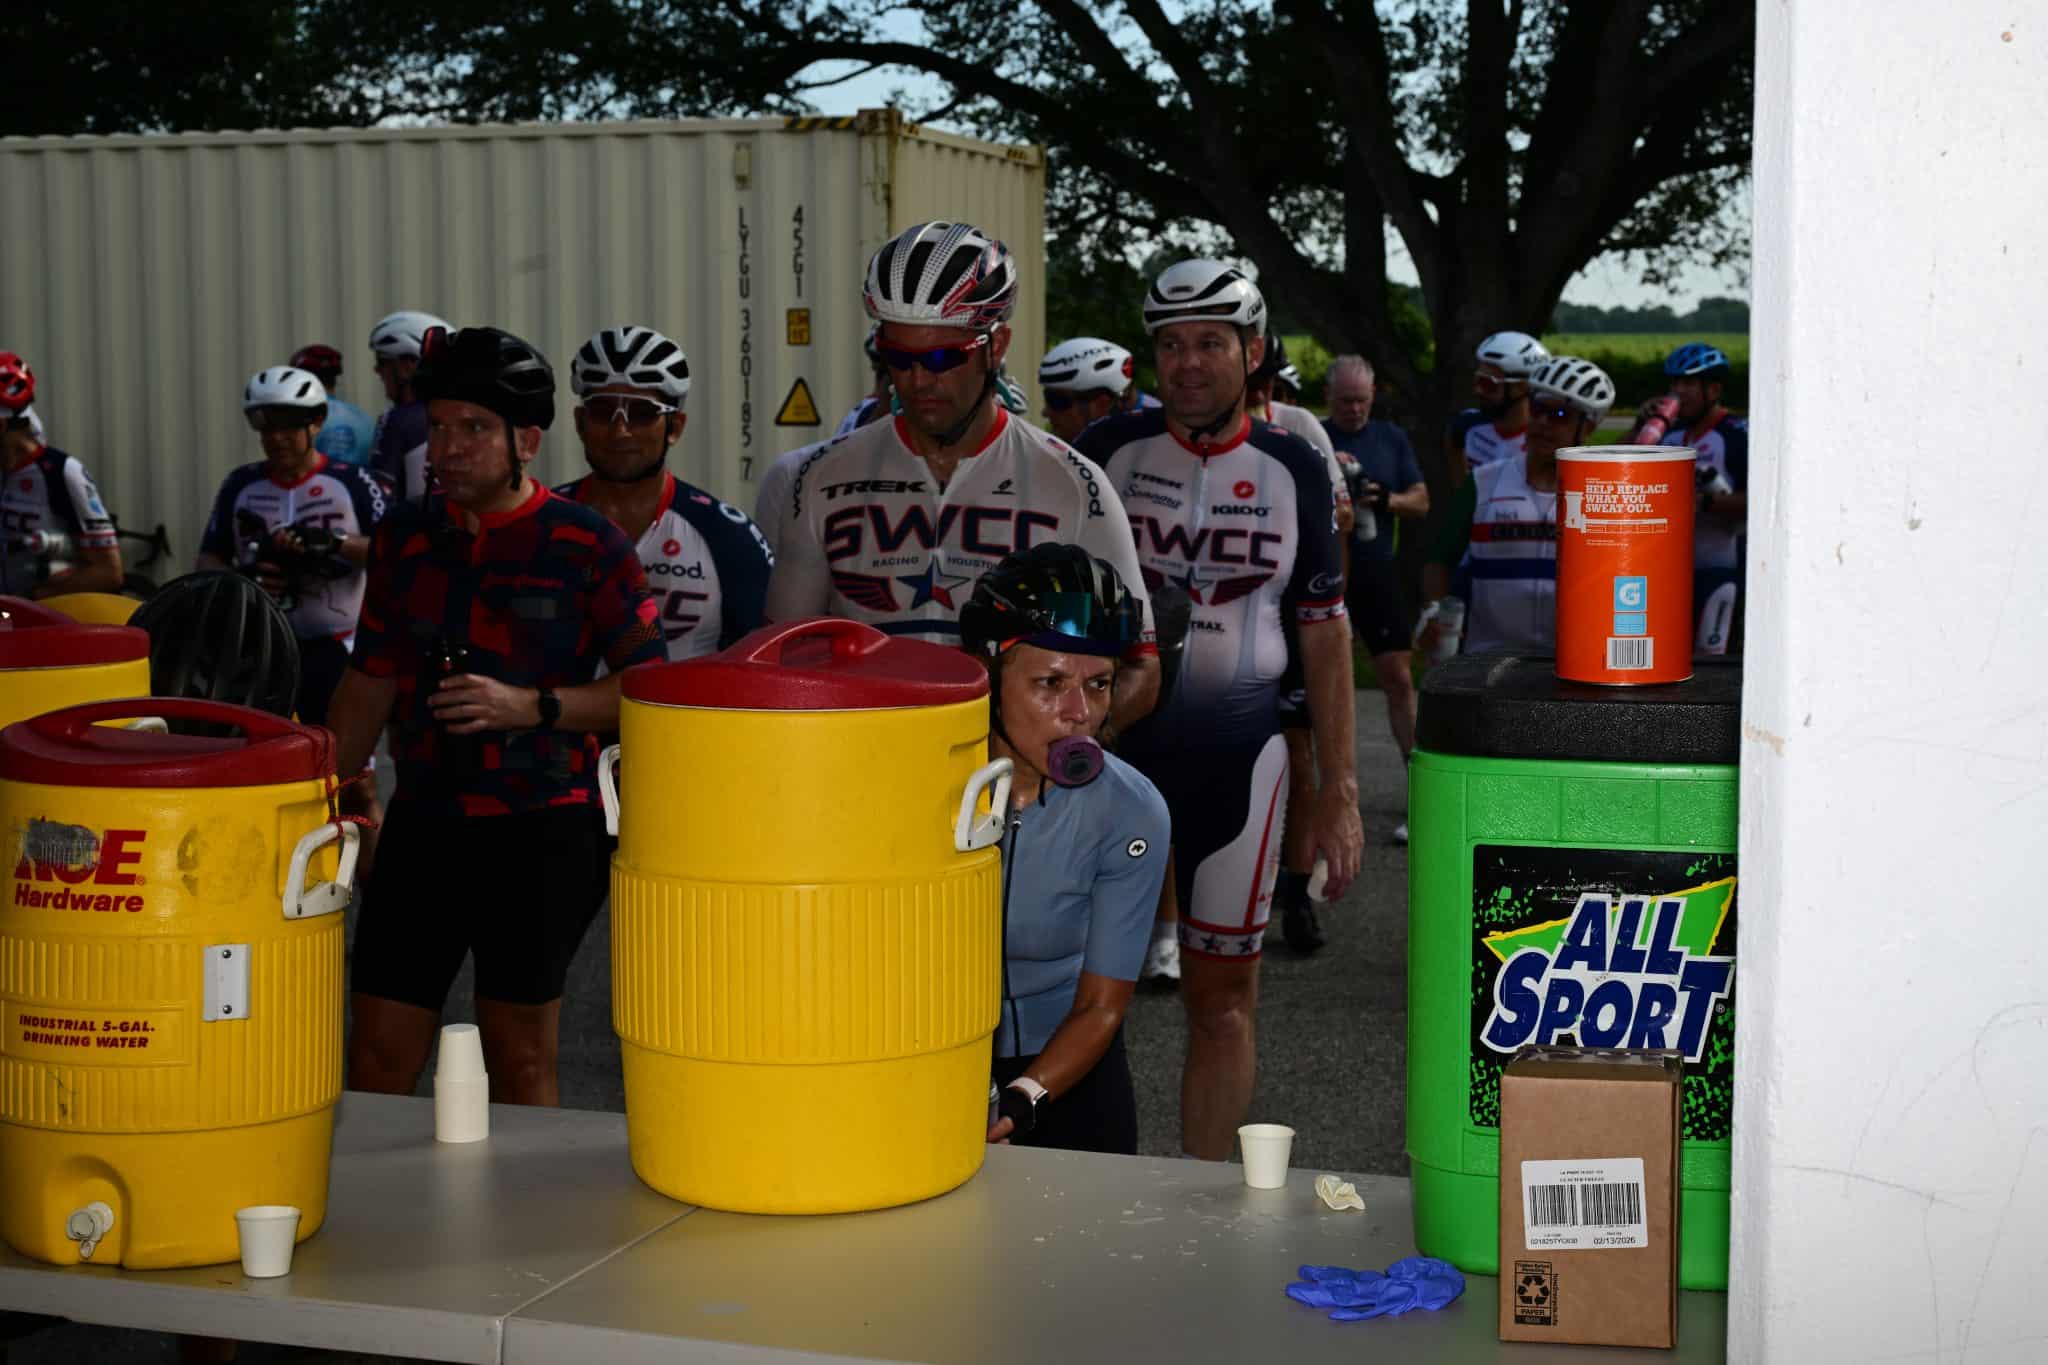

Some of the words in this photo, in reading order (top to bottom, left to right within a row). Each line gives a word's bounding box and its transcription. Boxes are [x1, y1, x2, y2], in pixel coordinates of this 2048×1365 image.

[741, 457, 752, 480] 7
[821, 479, 926, 500] TREK
[1584, 484, 1615, 494] HELP
[1617, 483, 1669, 494] REPLACE
[1584, 494, 1619, 503] WHAT
[1621, 494, 1646, 503] YOU
[1584, 503, 1624, 513] SWEAT
[1626, 503, 1654, 513] OUT.
[825, 504, 1058, 562] SWCC
[872, 556, 920, 568] RACING
[1618, 582, 1641, 606] G
[14, 883, 145, 913] Hardware
[1552, 895, 1688, 974] ALL
[1482, 949, 1735, 1060] SPORT
[19, 1014, 96, 1032] INDUSTRIAL
[102, 1020, 155, 1032] 5-GAL.
[23, 1031, 90, 1048] DRINKING
[96, 1037, 149, 1048] WATER
